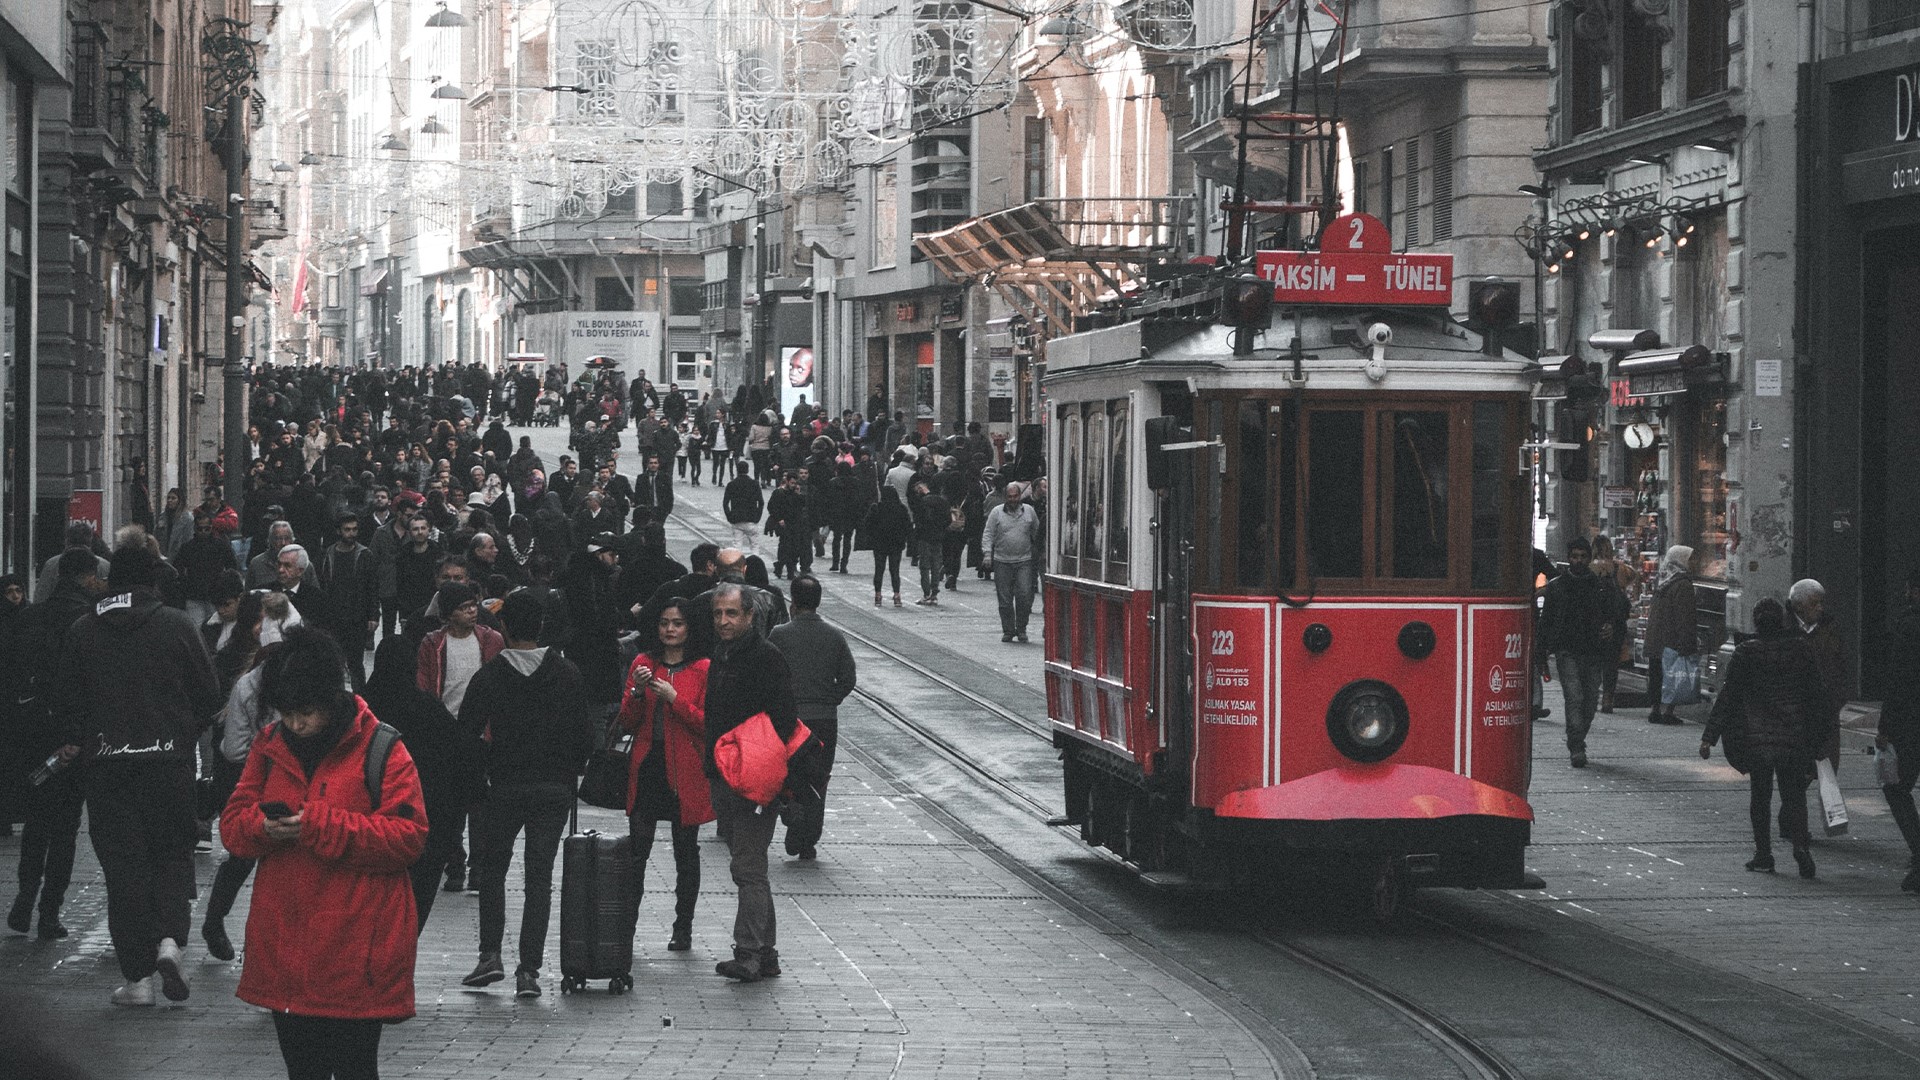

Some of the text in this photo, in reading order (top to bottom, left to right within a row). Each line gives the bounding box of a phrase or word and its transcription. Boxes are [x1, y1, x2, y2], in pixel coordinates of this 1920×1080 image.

[1349, 217, 1365, 249] 2
[1263, 259, 1336, 290] TAKSİM
[1383, 259, 1447, 291] TÜNEL
[577, 320, 644, 328] YIL BOYU SANAT
[571, 329, 585, 337] YIL
[586, 329, 609, 338] BOYU
[1211, 630, 1234, 655] 223
[1233, 677, 1249, 687] 153
[1205, 699, 1256, 711] ASILMAK YASAK
[1209, 712, 1258, 725] TEHLİKELİDİR
[1483, 716, 1493, 727] VE
